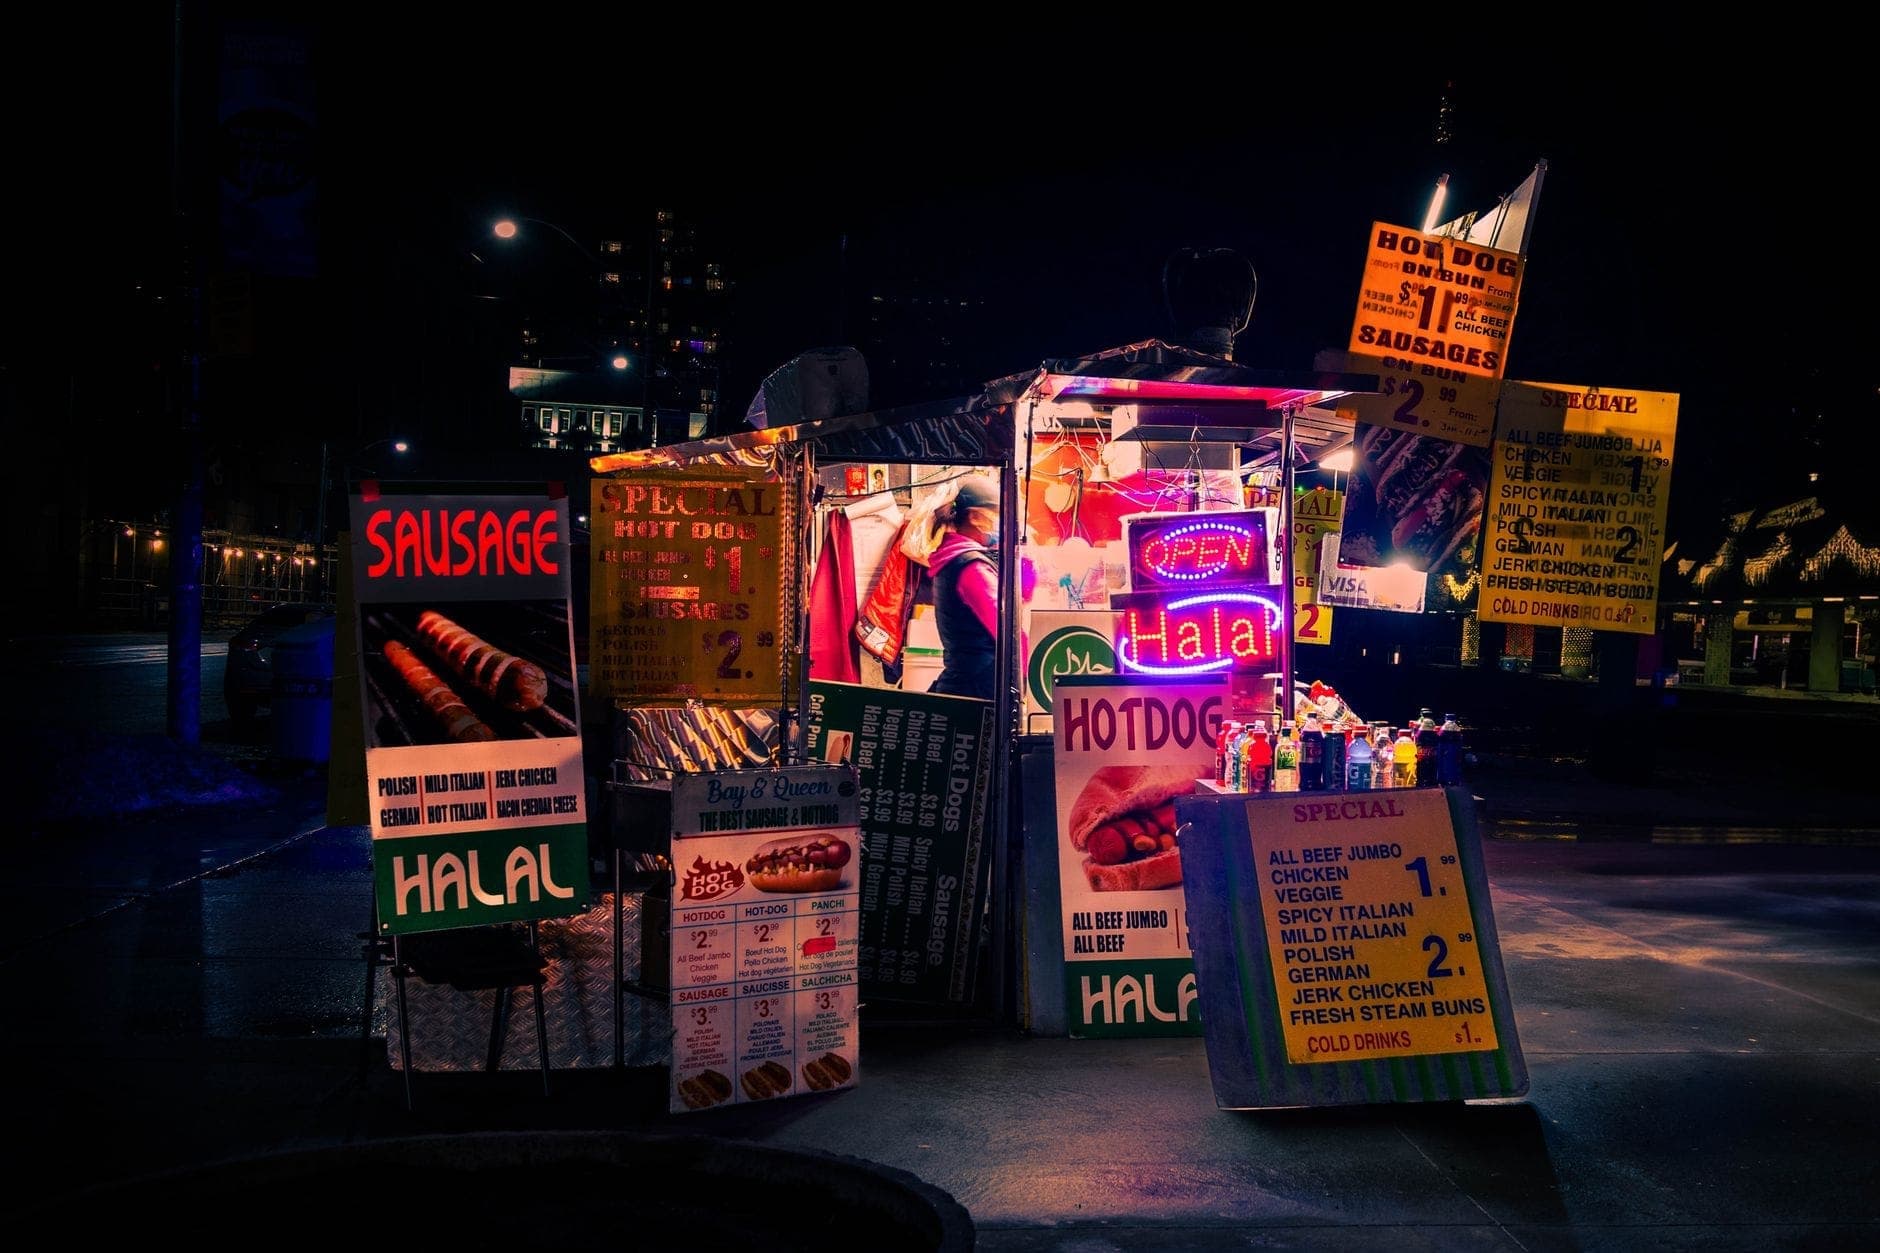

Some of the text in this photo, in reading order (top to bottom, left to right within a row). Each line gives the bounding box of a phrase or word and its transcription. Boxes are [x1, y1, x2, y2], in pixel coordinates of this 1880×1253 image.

[1377, 230, 1518, 277] HOT DOG
[1402, 261, 1485, 290] ON BUN
[1487, 285, 1516, 299] From:
[1455, 309, 1510, 329] ALL BEEF
[1455, 321, 1507, 340] CHICKEN
[1358, 325, 1499, 370] SAUSAGES
[1383, 356, 1467, 384] ON BUN
[1541, 391, 1637, 413] SPECIAL
[1448, 407, 1477, 422] From:
[1507, 429, 1532, 444] ALL
[1536, 432, 1571, 447] BEEF
[1504, 447, 1572, 466] CHICKEN
[1503, 465, 1561, 483] VEGGIE
[600, 484, 775, 516] SPECIAL
[1501, 484, 1617, 507] SPICY ITALIAN
[1499, 502, 1606, 523] MILD ITALIAN
[614, 520, 757, 540] HOT DOG
[1496, 520, 1556, 537] POLISH
[366, 509, 558, 577] SAUSAGE
[1145, 525, 1251, 570] OPEN
[1495, 539, 1564, 557] GERMAN
[1493, 557, 1612, 579] JERK CHICKEN
[1328, 576, 1368, 595] VISA
[1487, 574, 1541, 592] FRESH
[1545, 578, 1600, 597] STEAM
[622, 602, 750, 620] SAUSAGES
[1493, 598, 1579, 619] COLD DRINKS
[1129, 606, 1273, 664] Halal
[1053, 646, 1113, 675] حلال
[880, 708, 903, 751] Veggie
[928, 712, 948, 731] All
[1063, 696, 1224, 752] HOTDOG
[856, 704, 881, 770] Halal Beef
[902, 710, 925, 761] Chicken
[924, 735, 945, 764] Beef
[378, 767, 557, 797] POLISH MILD ITALIAN JERK CHICKEN
[706, 775, 832, 809] Bay & Queen
[941, 732, 974, 832] Hot Dogs
[381, 807, 420, 827] GERMAN
[427, 804, 447, 824] HOT
[450, 802, 487, 822] ITALIAN
[553, 795, 577, 814] CHEESE
[700, 803, 840, 832] THE BEST SAUSAGE & HOTDOG
[1293, 800, 1404, 823] SPECIAL
[869, 832, 889, 859] Mild
[889, 835, 910, 863] Mild
[909, 837, 932, 872] Spicy
[1269, 843, 1402, 866] ALL BEEF JUMBO
[393, 843, 575, 915] HALAL
[692, 870, 731, 886] HOT
[884, 867, 907, 907] Polish
[1271, 866, 1349, 885] CHICKEN
[691, 881, 734, 896] DOG
[862, 864, 885, 912] German
[905, 875, 928, 915] Italian
[1274, 886, 1343, 904] VEGGIE
[683, 910, 726, 922] HOTDOG
[745, 904, 788, 917] HOT-DOG
[811, 899, 844, 910] PANCHI
[1278, 902, 1414, 925] SPICY ITALIAN
[924, 874, 957, 967] Sausage
[1072, 909, 1168, 931] ALL BEEF JUMBO
[1073, 934, 1125, 954] ALL BEEF
[1281, 922, 1407, 945] MILD ITALIAN
[1284, 945, 1355, 964] POLISH
[689, 963, 719, 972] Chicken
[691, 974, 717, 983] Veggie
[1288, 964, 1370, 984] GERMAN
[742, 980, 790, 994] SAUCISSE
[802, 973, 852, 988] SALCHICHA
[679, 987, 729, 1002] SAUSAGE
[1081, 973, 1201, 1025] HALA
[1292, 981, 1435, 1005] JERK CHICKEN
[1290, 998, 1486, 1026] FRESH STEAM BUNS
[1307, 1031, 1411, 1054] COLD DRINKS
